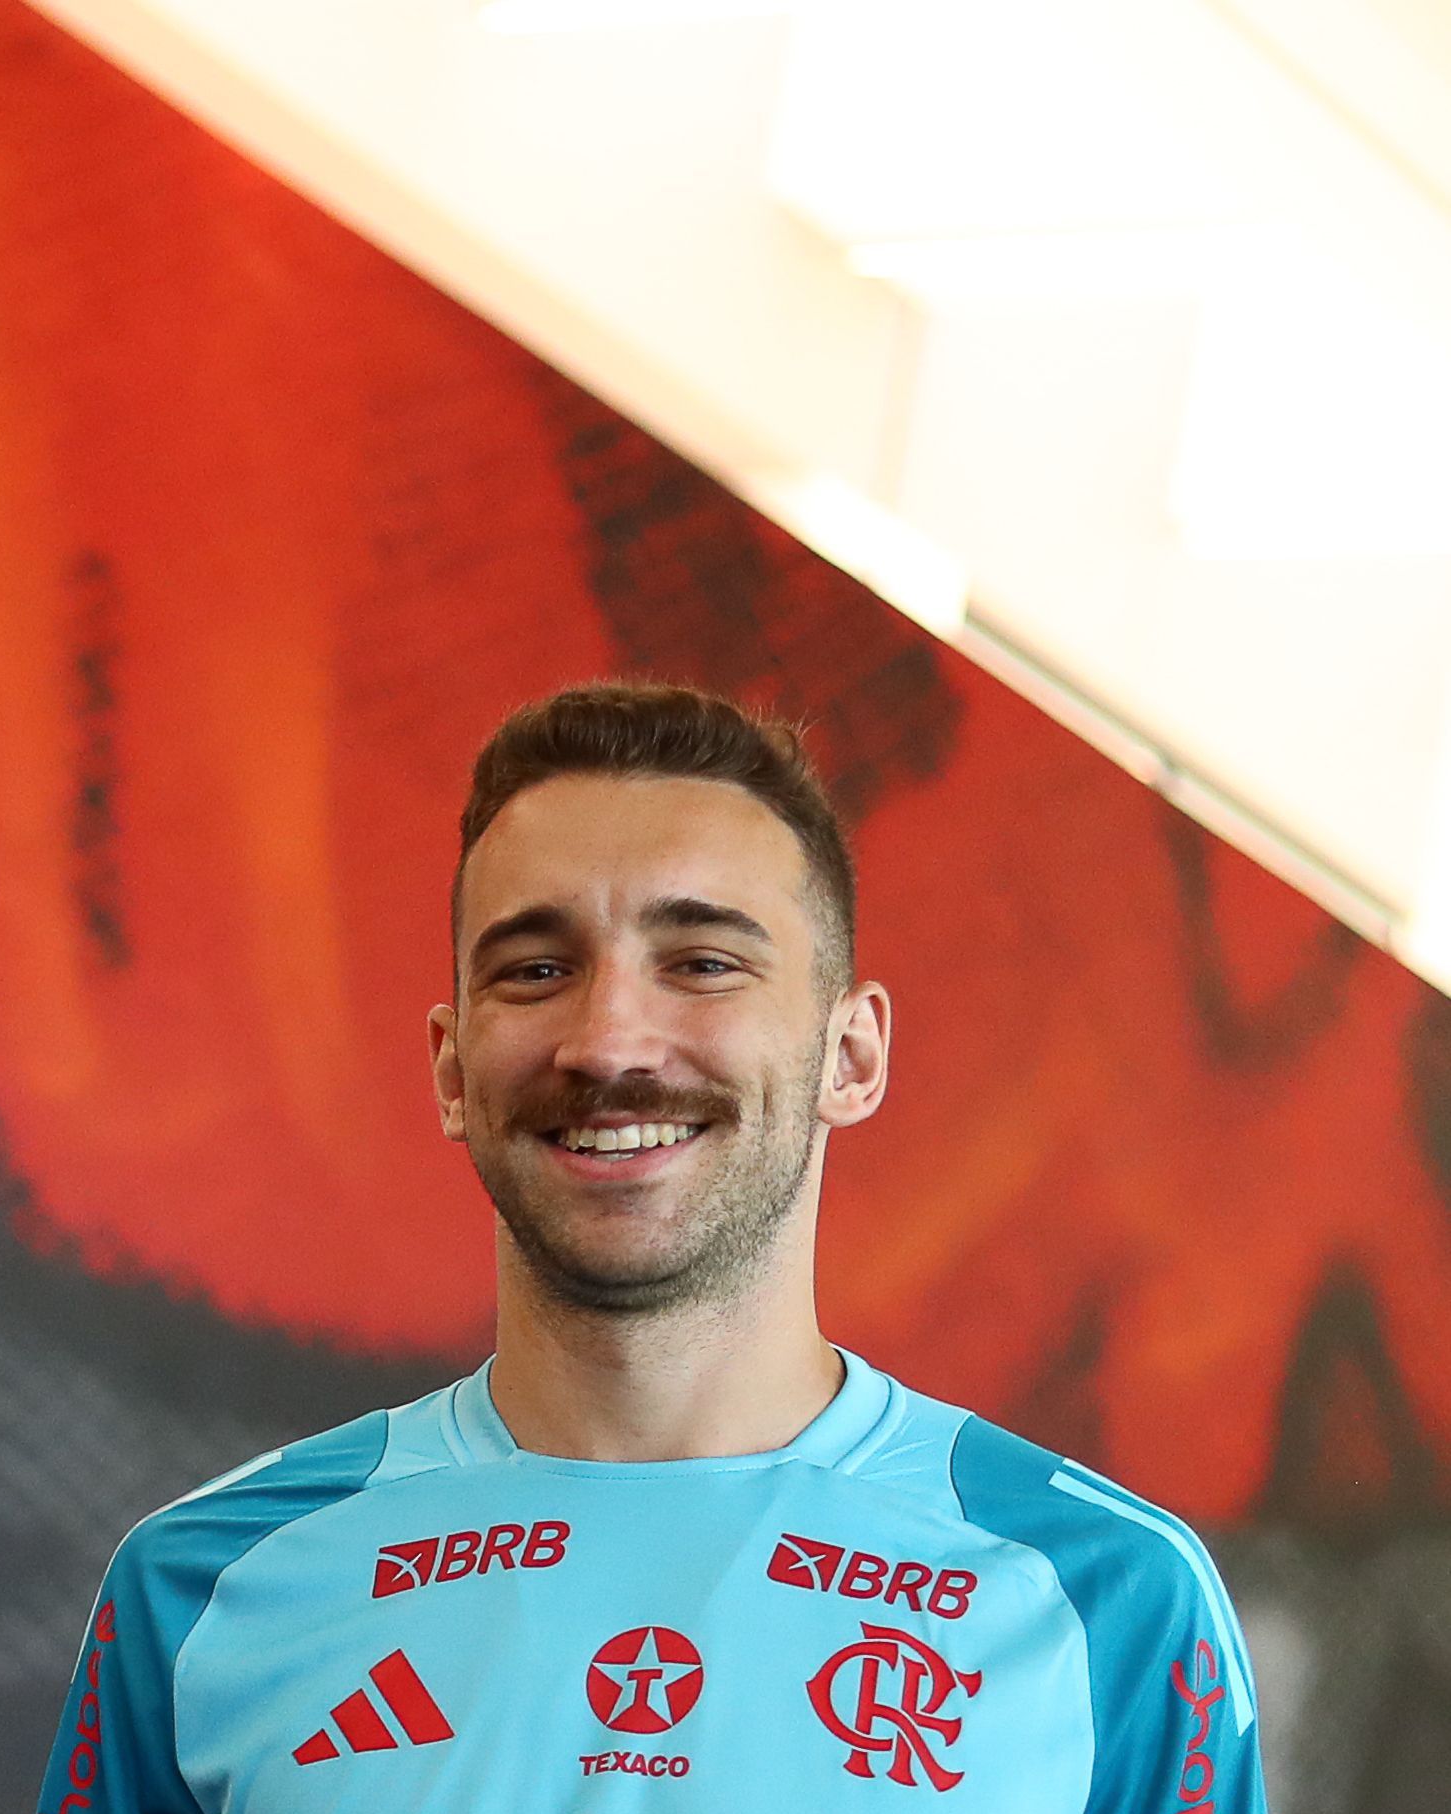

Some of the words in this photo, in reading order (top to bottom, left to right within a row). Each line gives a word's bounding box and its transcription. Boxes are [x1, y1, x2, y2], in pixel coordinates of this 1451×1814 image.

[435, 1520, 571, 1583] BRB
[836, 1551, 978, 1620] BRB
[579, 1751, 690, 1779] TEXACO
